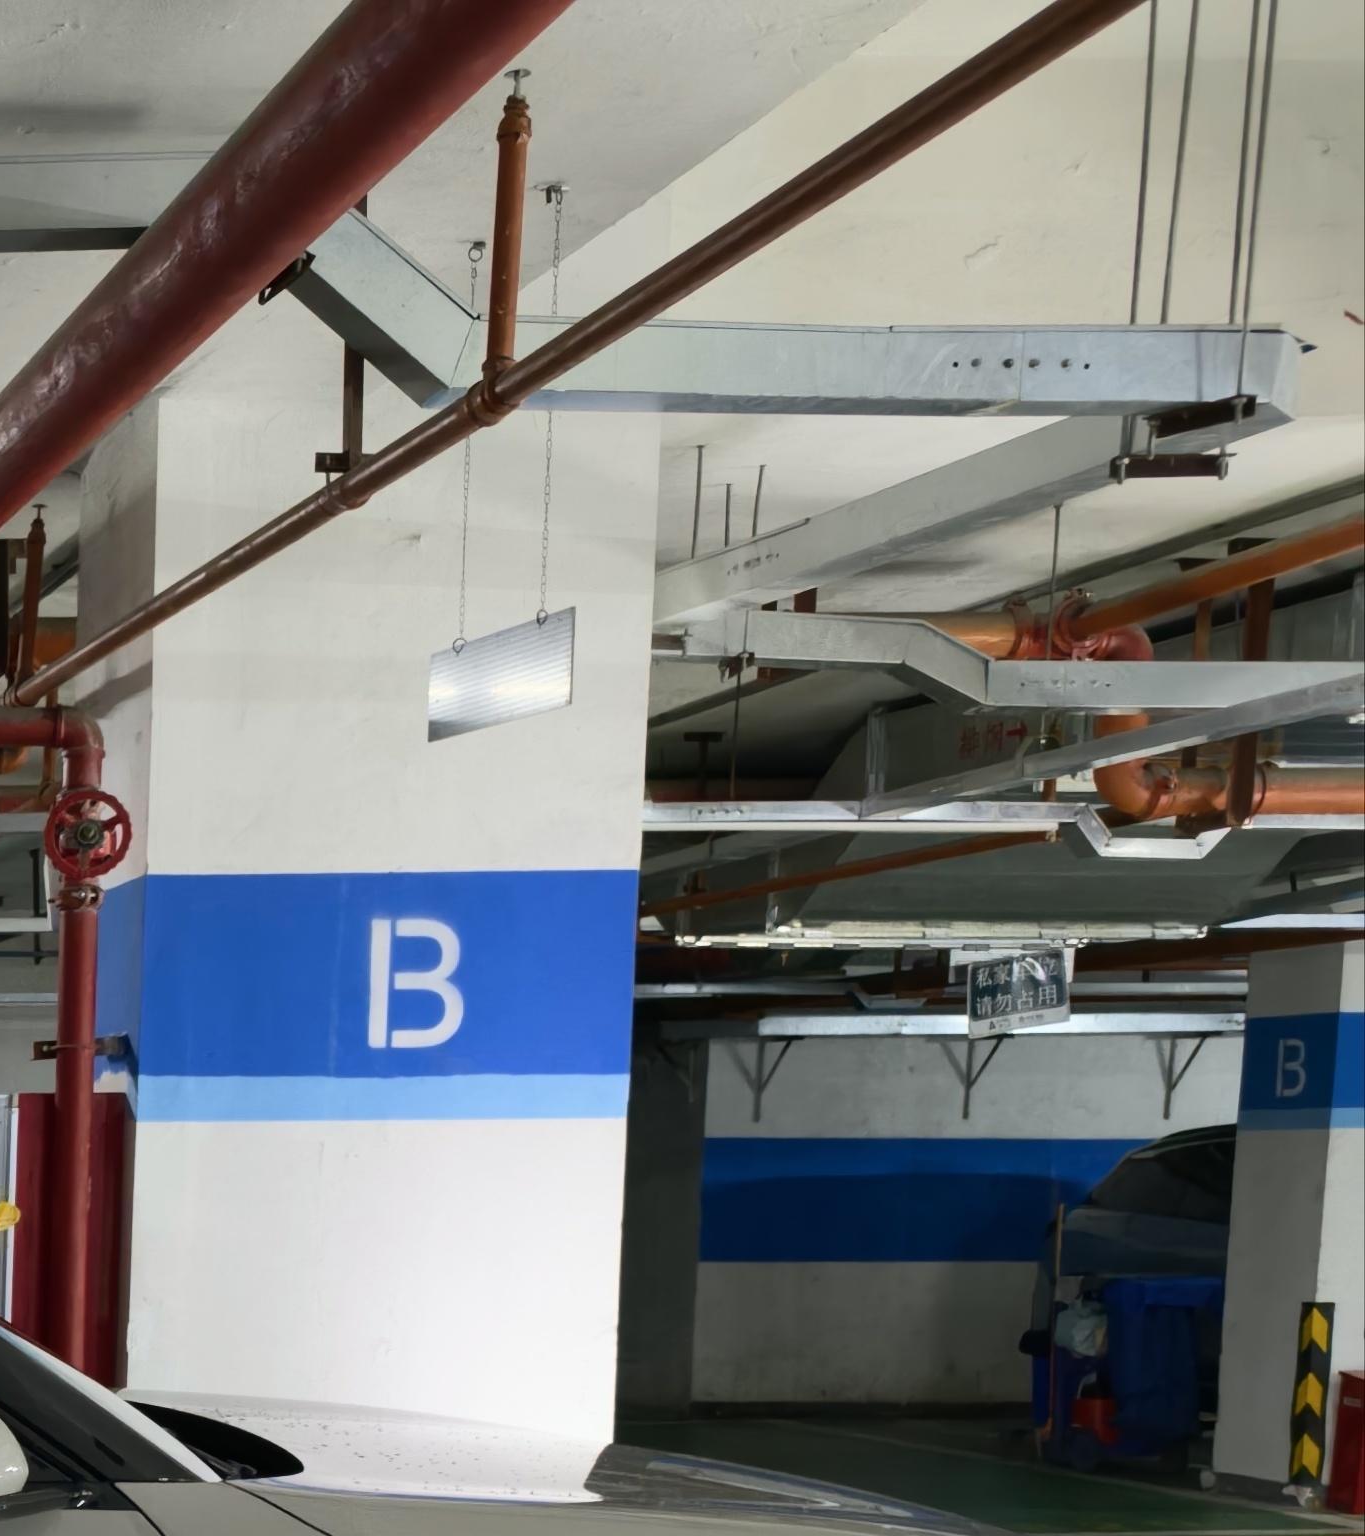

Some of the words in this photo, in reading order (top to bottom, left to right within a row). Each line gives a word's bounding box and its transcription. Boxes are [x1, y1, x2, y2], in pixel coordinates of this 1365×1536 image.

[367, 917, 464, 1049] B
[976, 984, 1058, 1017] 请勿占用
[1276, 1037, 1307, 1098] B
